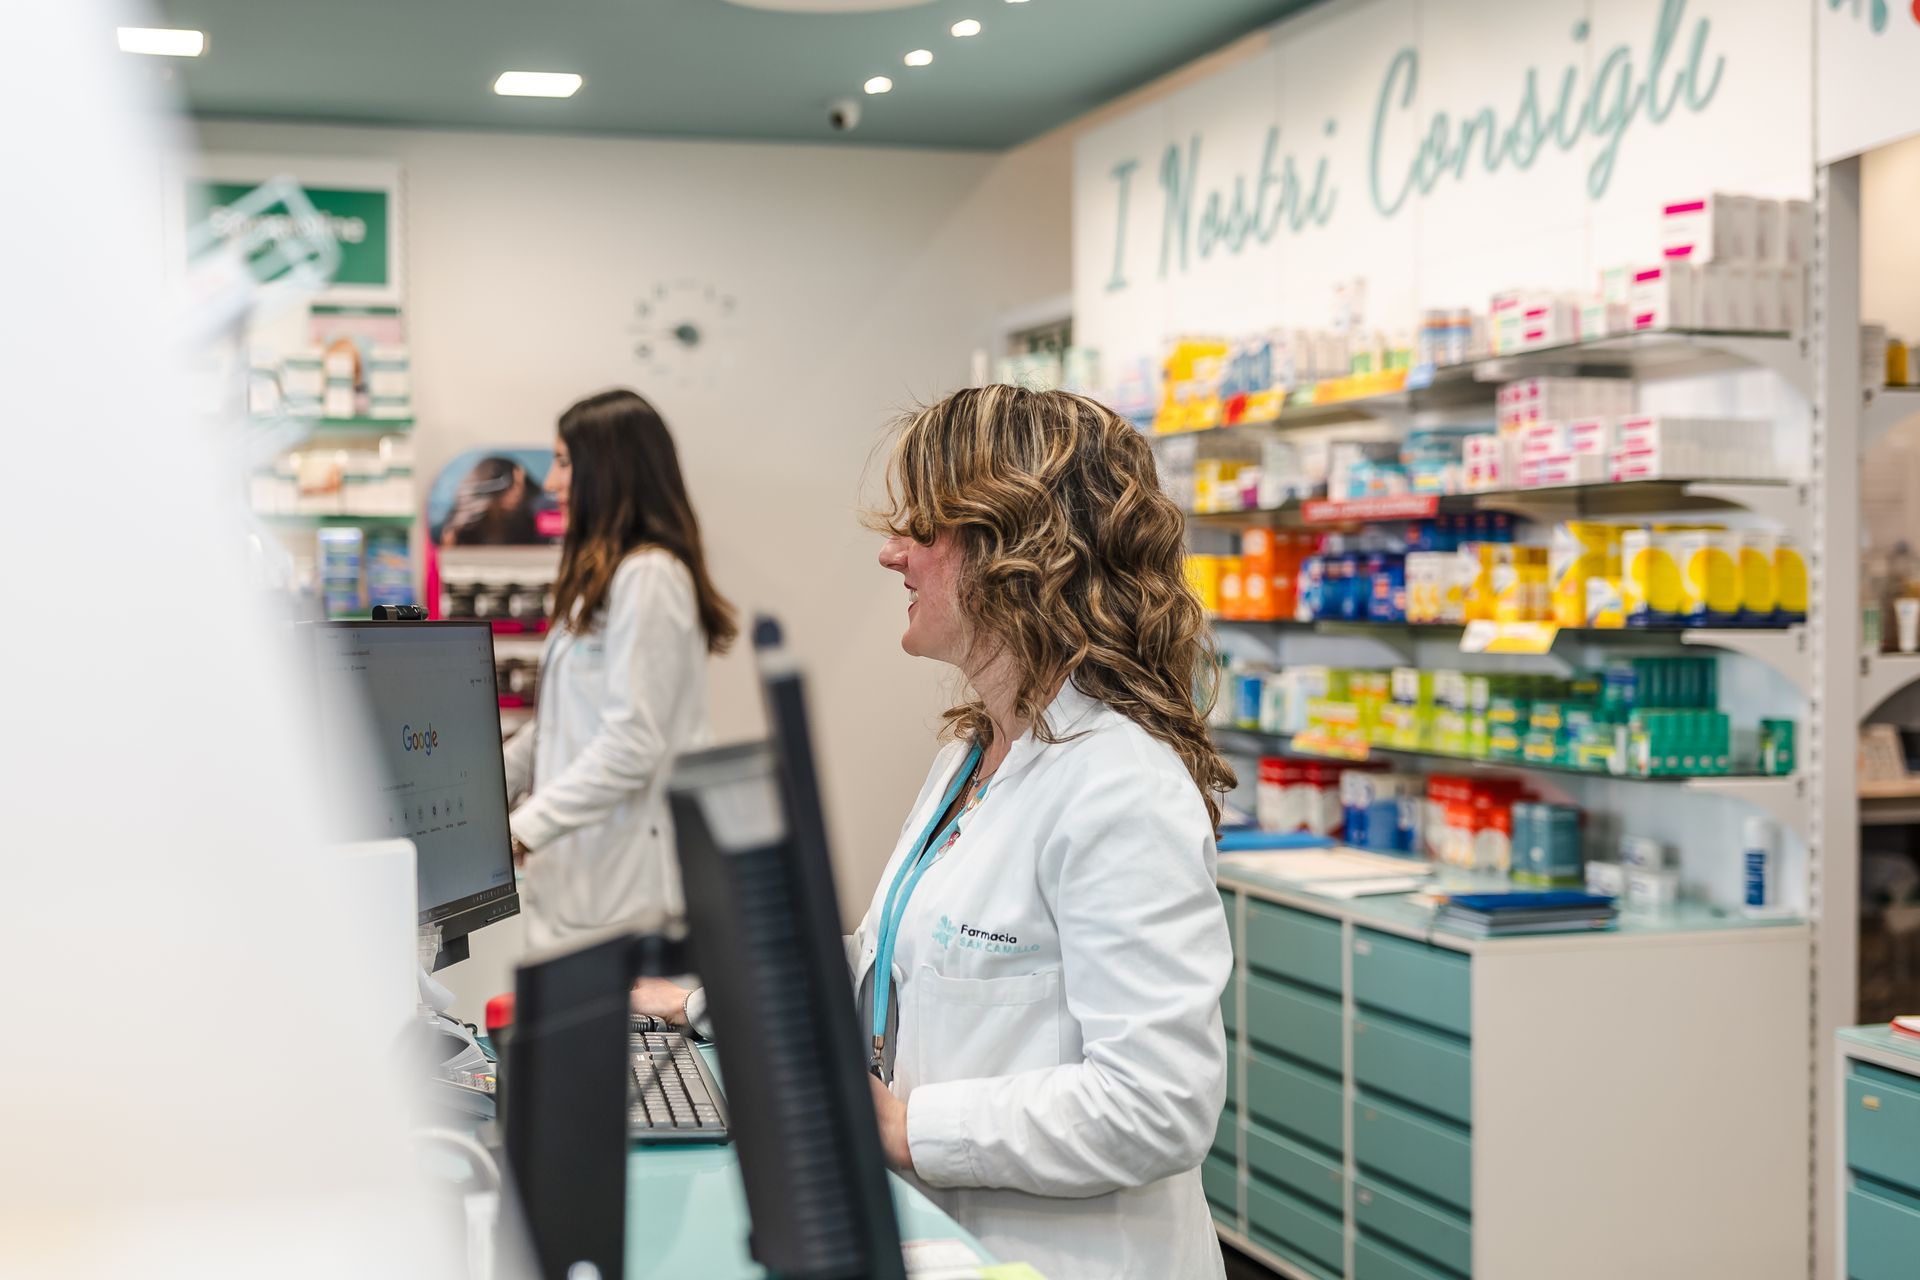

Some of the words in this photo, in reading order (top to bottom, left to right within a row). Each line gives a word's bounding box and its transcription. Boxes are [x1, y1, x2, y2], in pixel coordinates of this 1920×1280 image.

[1105, 157, 1139, 292] I
[1156, 117, 1339, 280] Nostri
[1370, 0, 1726, 217] Consigli
[402, 722, 438, 756] Google
[959, 937, 981, 949] SAN
[985, 943, 1040, 953] CAMILLO
[960, 924, 1017, 943] Farmacia
